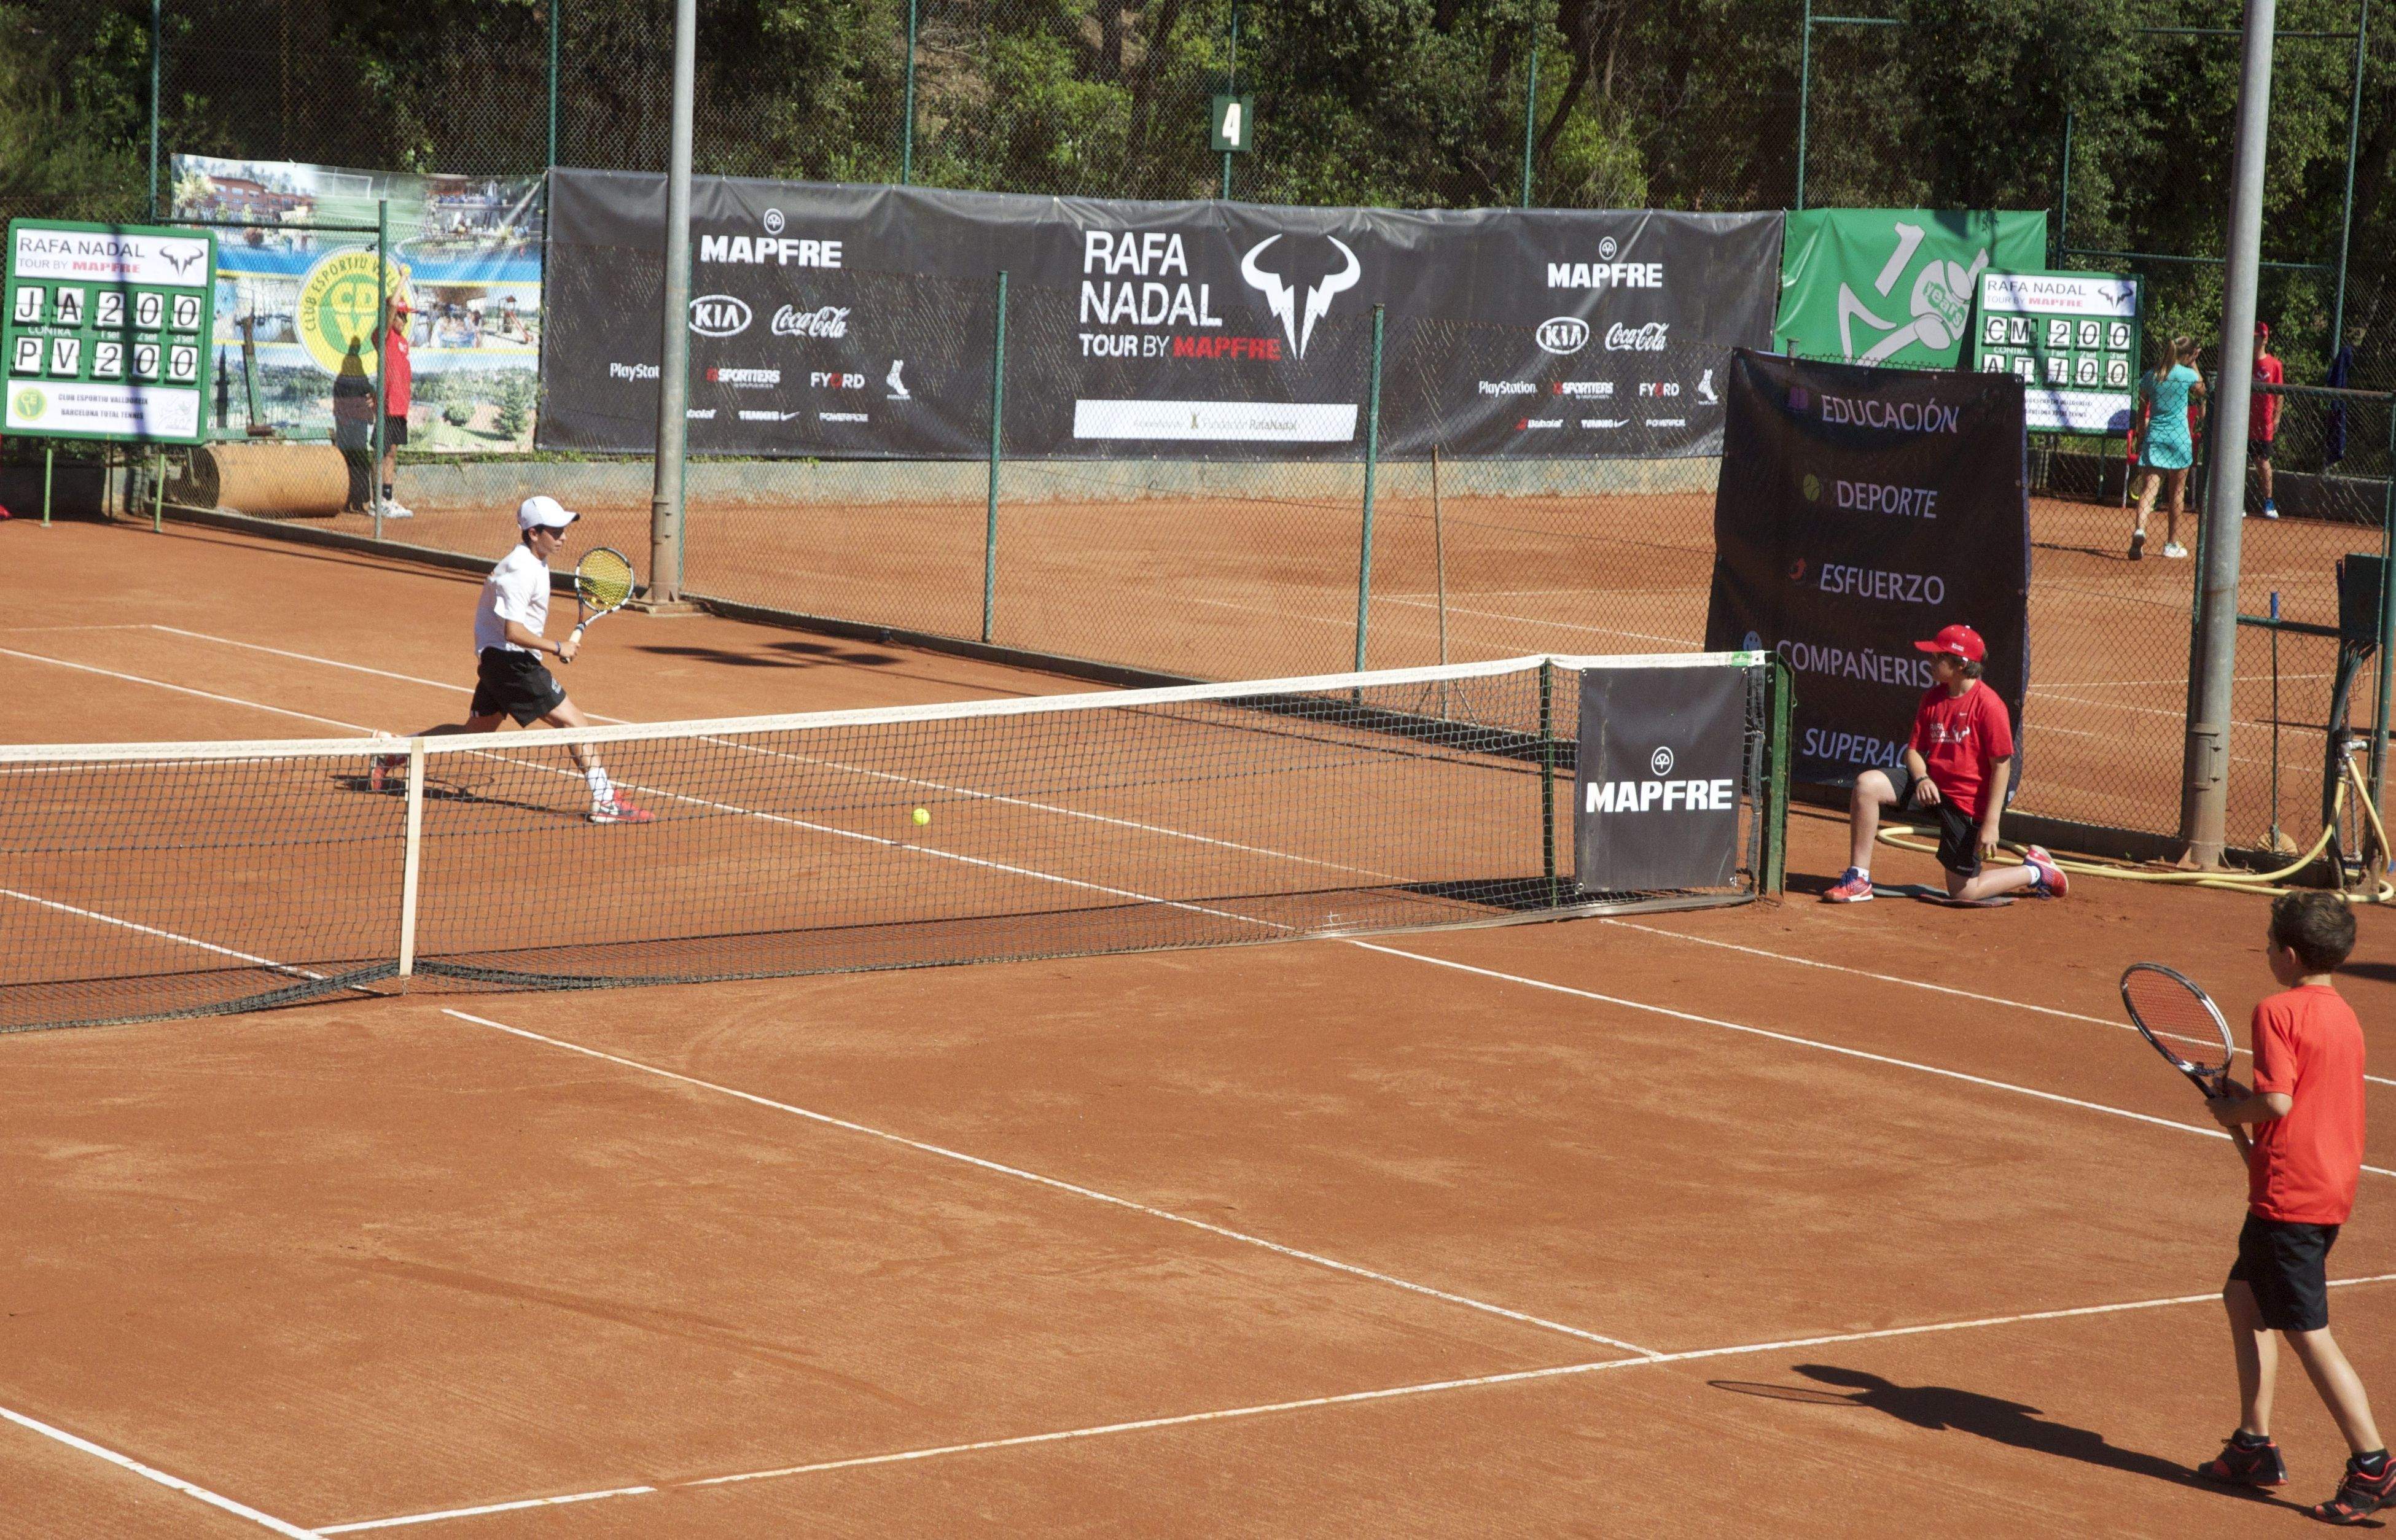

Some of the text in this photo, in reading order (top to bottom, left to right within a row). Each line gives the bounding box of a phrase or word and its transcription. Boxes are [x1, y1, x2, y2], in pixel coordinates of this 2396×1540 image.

[1222, 103, 1241, 146] 4
[20, 237, 146, 258] RAFA NADAL
[700, 235, 842, 268] MAPFRE
[1084, 230, 1188, 276] RAFA
[19, 258, 141, 273] TOUR BY MAPFRE
[1548, 263, 1663, 288] MAPFRE
[1988, 280, 2086, 295] RAFA NADAL
[2029, 298, 2083, 307] MAPFRE
[695, 303, 740, 329] KIA
[1080, 280, 1222, 327] NADAL
[1079, 333, 1282, 361] TOUR BY MAPFRE
[1545, 325, 1583, 347] KIA
[610, 362, 660, 383] PlayStat
[1478, 380, 1537, 398] PlayStation
[1821, 395, 1959, 434] EDUCACIÓN
[1836, 480, 1938, 519] DEPORTE
[1820, 563, 1945, 605] ESFUERZO
[1776, 640, 1934, 688] COMPAÑERIS
[1803, 728, 1908, 768] SUPERAC
[1586, 779, 1733, 813] MAPFRE
